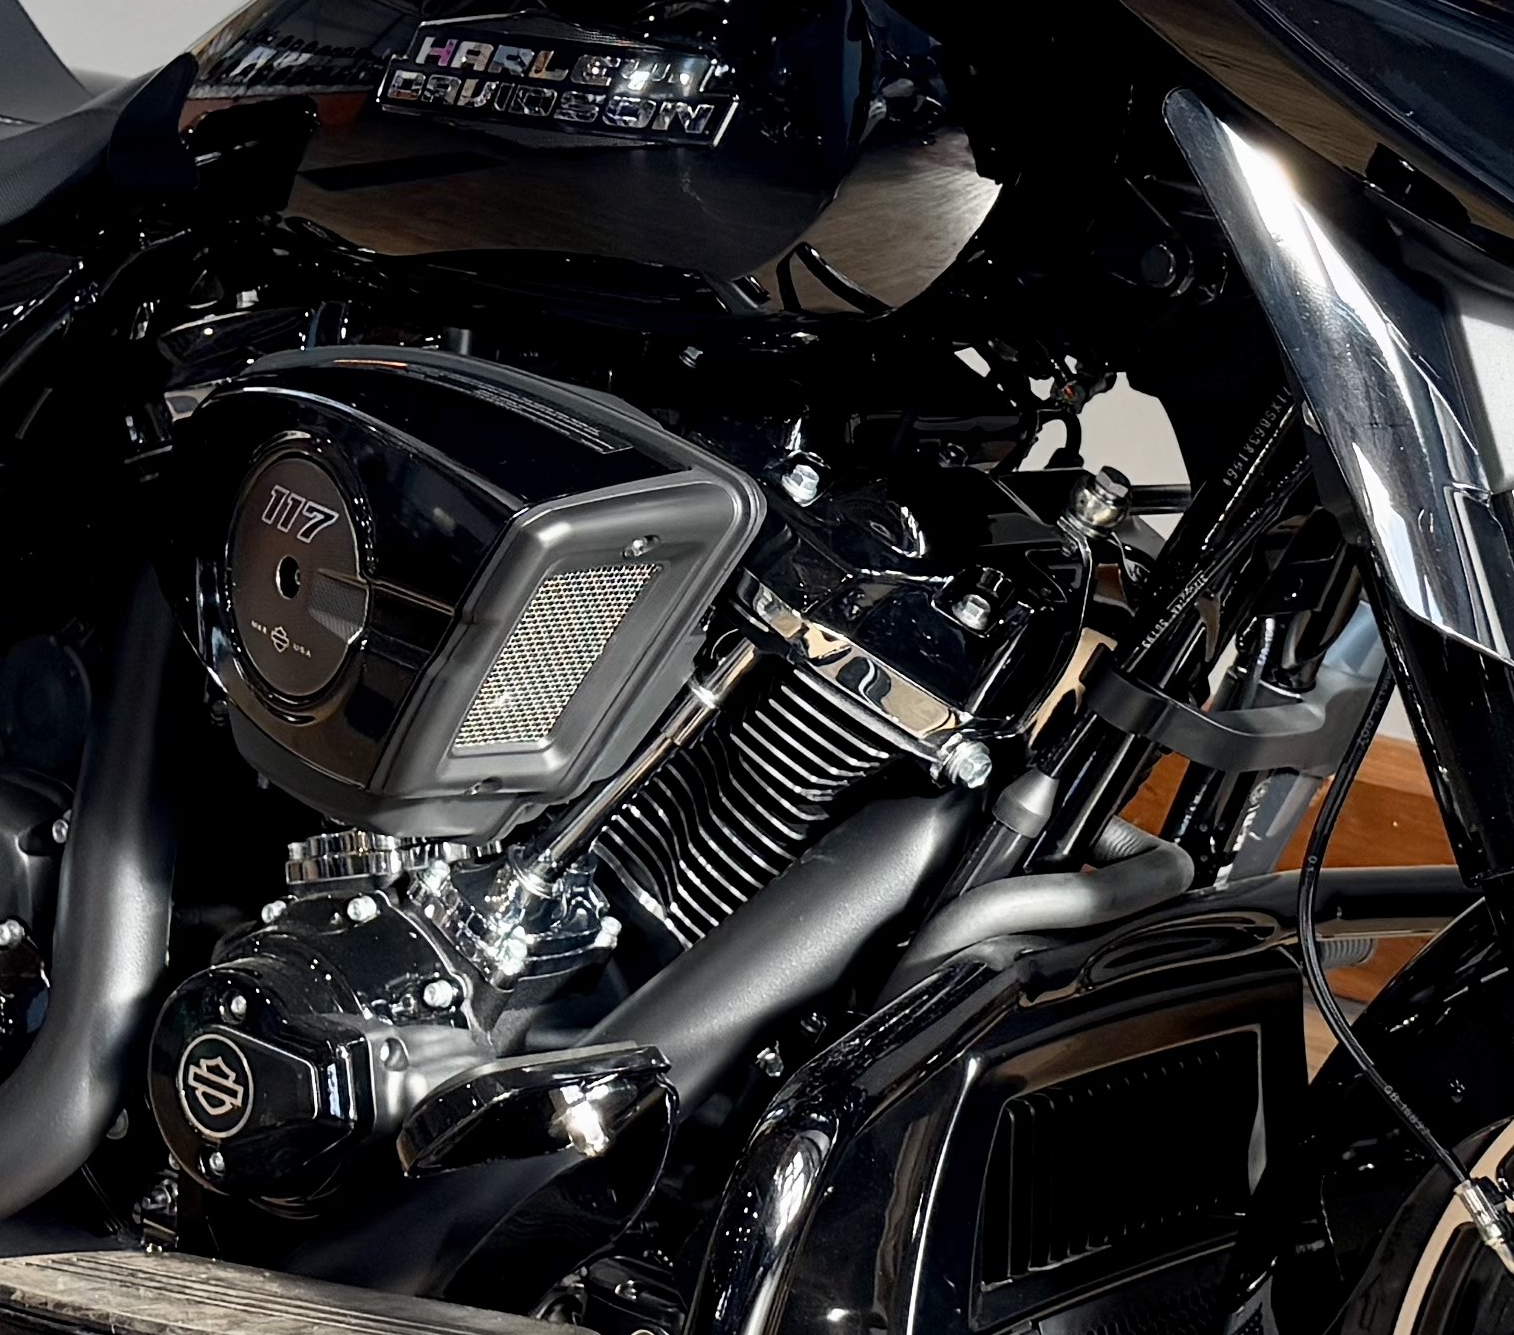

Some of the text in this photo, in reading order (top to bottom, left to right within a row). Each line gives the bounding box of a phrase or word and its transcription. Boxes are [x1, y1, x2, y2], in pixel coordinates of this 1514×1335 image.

[386, 69, 715, 135] DAVIDSON
[260, 484, 339, 544] 117
[292, 643, 312, 659] USA
